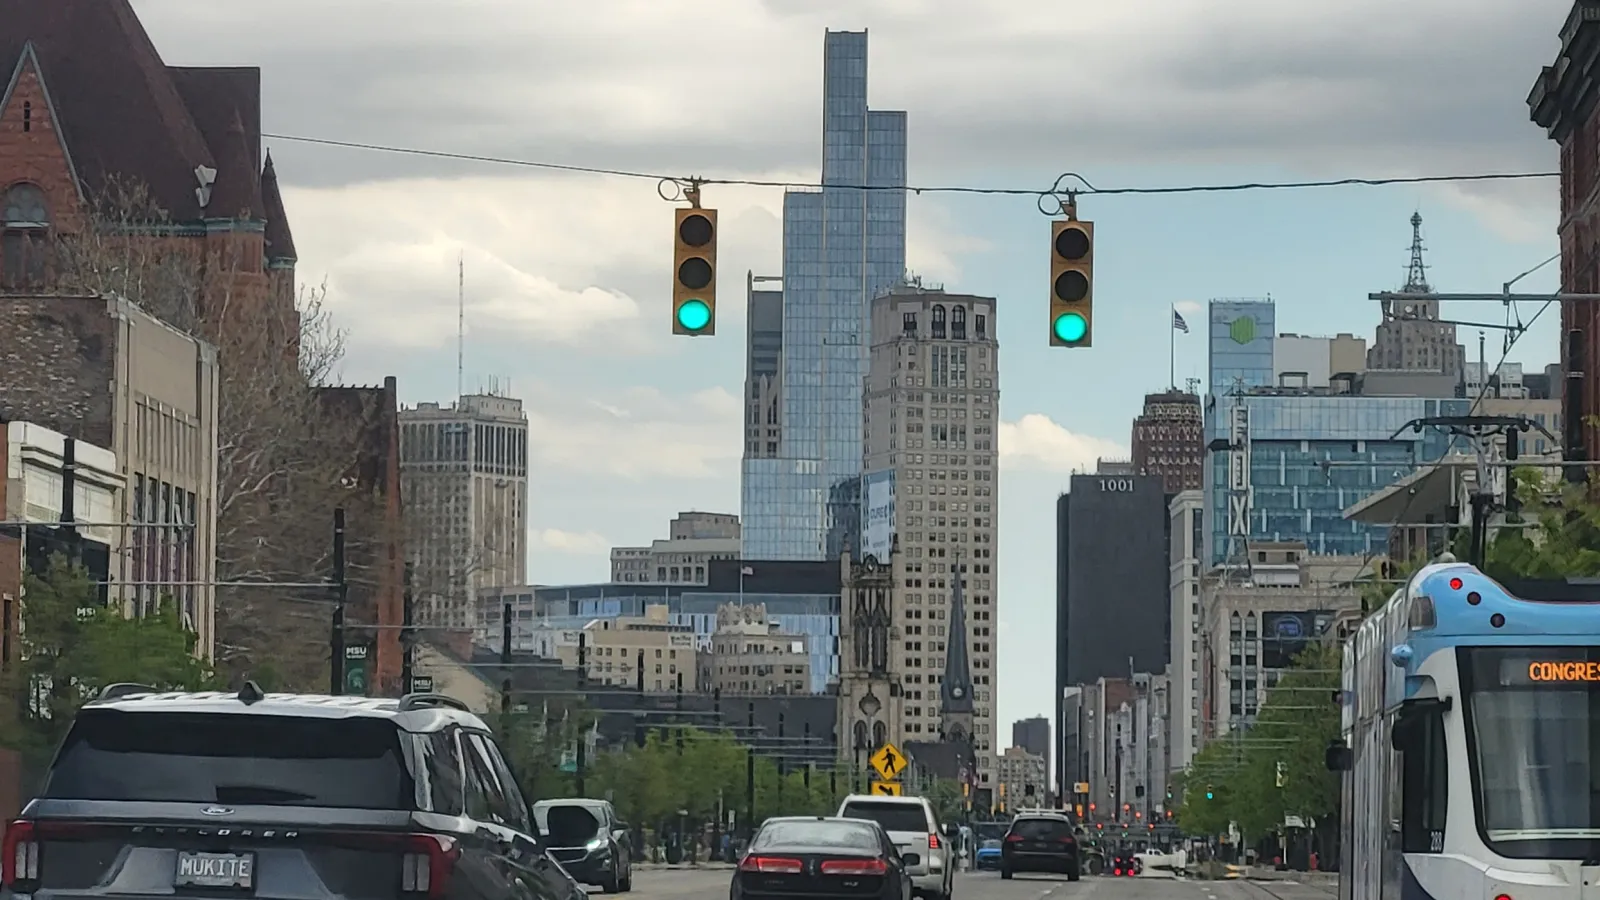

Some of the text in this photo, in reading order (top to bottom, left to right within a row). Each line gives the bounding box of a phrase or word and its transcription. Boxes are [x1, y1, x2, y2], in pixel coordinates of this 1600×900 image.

[1230, 404, 1250, 536] FOX
[1099, 479, 1133, 492] 1001
[76, 607, 96, 616] MS
[345, 646, 367, 655] MSU
[131, 826, 298, 838] EXPLORER
[180, 858, 250, 877] MUKITE
